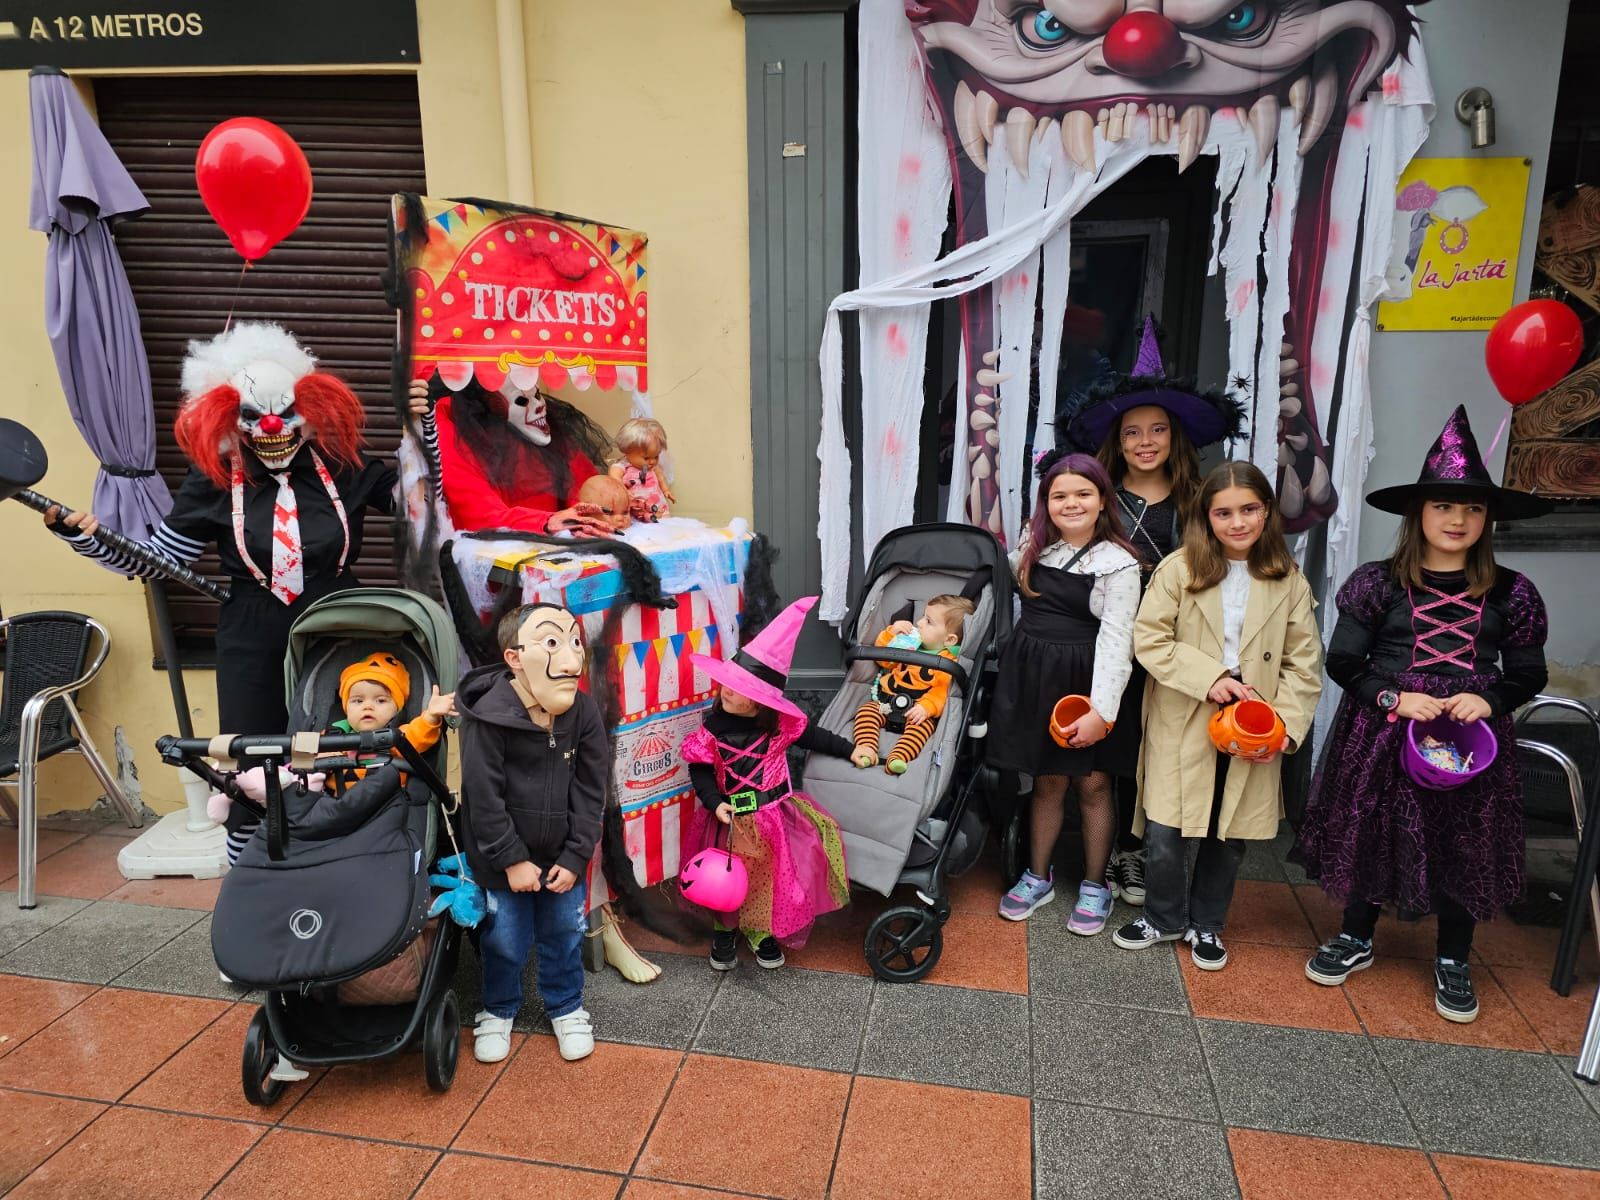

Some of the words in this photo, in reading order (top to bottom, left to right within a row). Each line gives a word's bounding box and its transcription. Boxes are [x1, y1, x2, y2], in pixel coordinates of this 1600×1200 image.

[29, 16, 50, 40] A
[53, 15, 85, 39] 12
[91, 12, 203, 38] METROS
[464, 280, 616, 327] TICKETS
